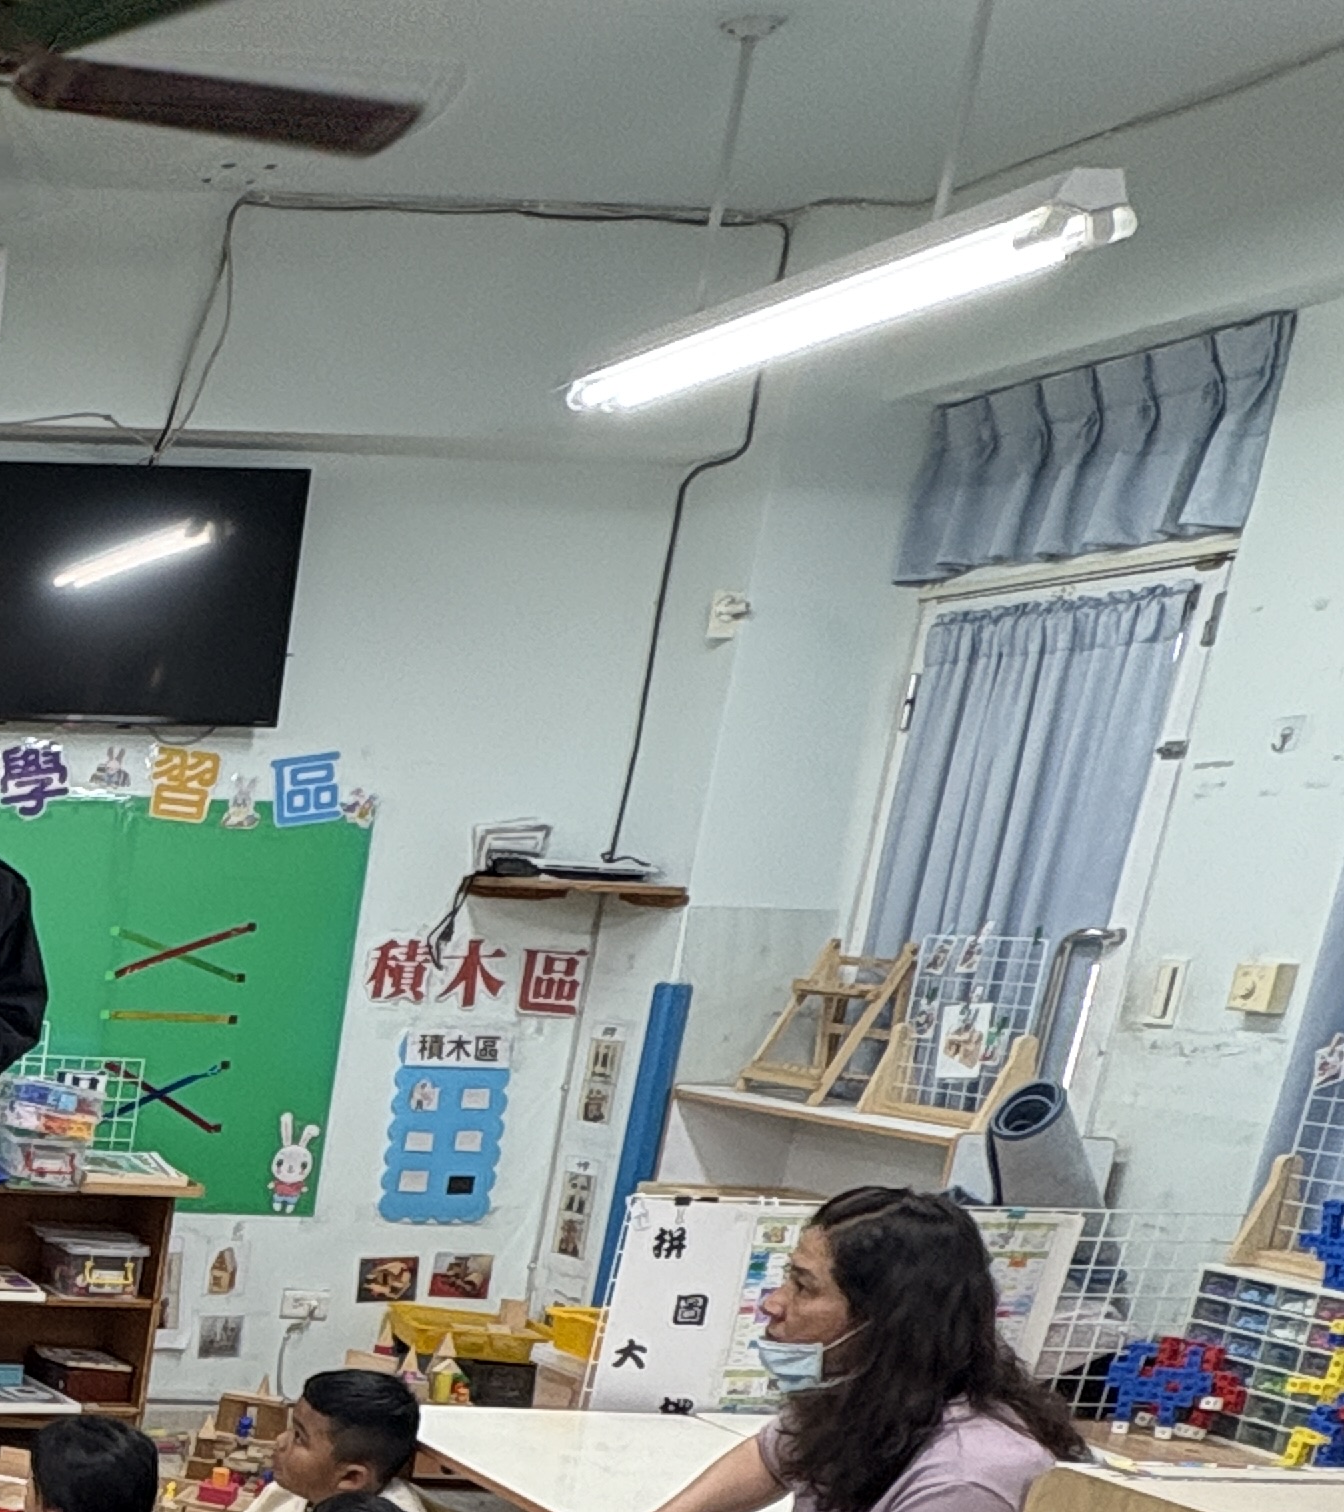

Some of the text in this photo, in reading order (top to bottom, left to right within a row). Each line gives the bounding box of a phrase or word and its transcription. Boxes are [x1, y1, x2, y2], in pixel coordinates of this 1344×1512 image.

[365, 938, 590, 1015] 積木區
[418, 1034, 501, 1062] 積木區
